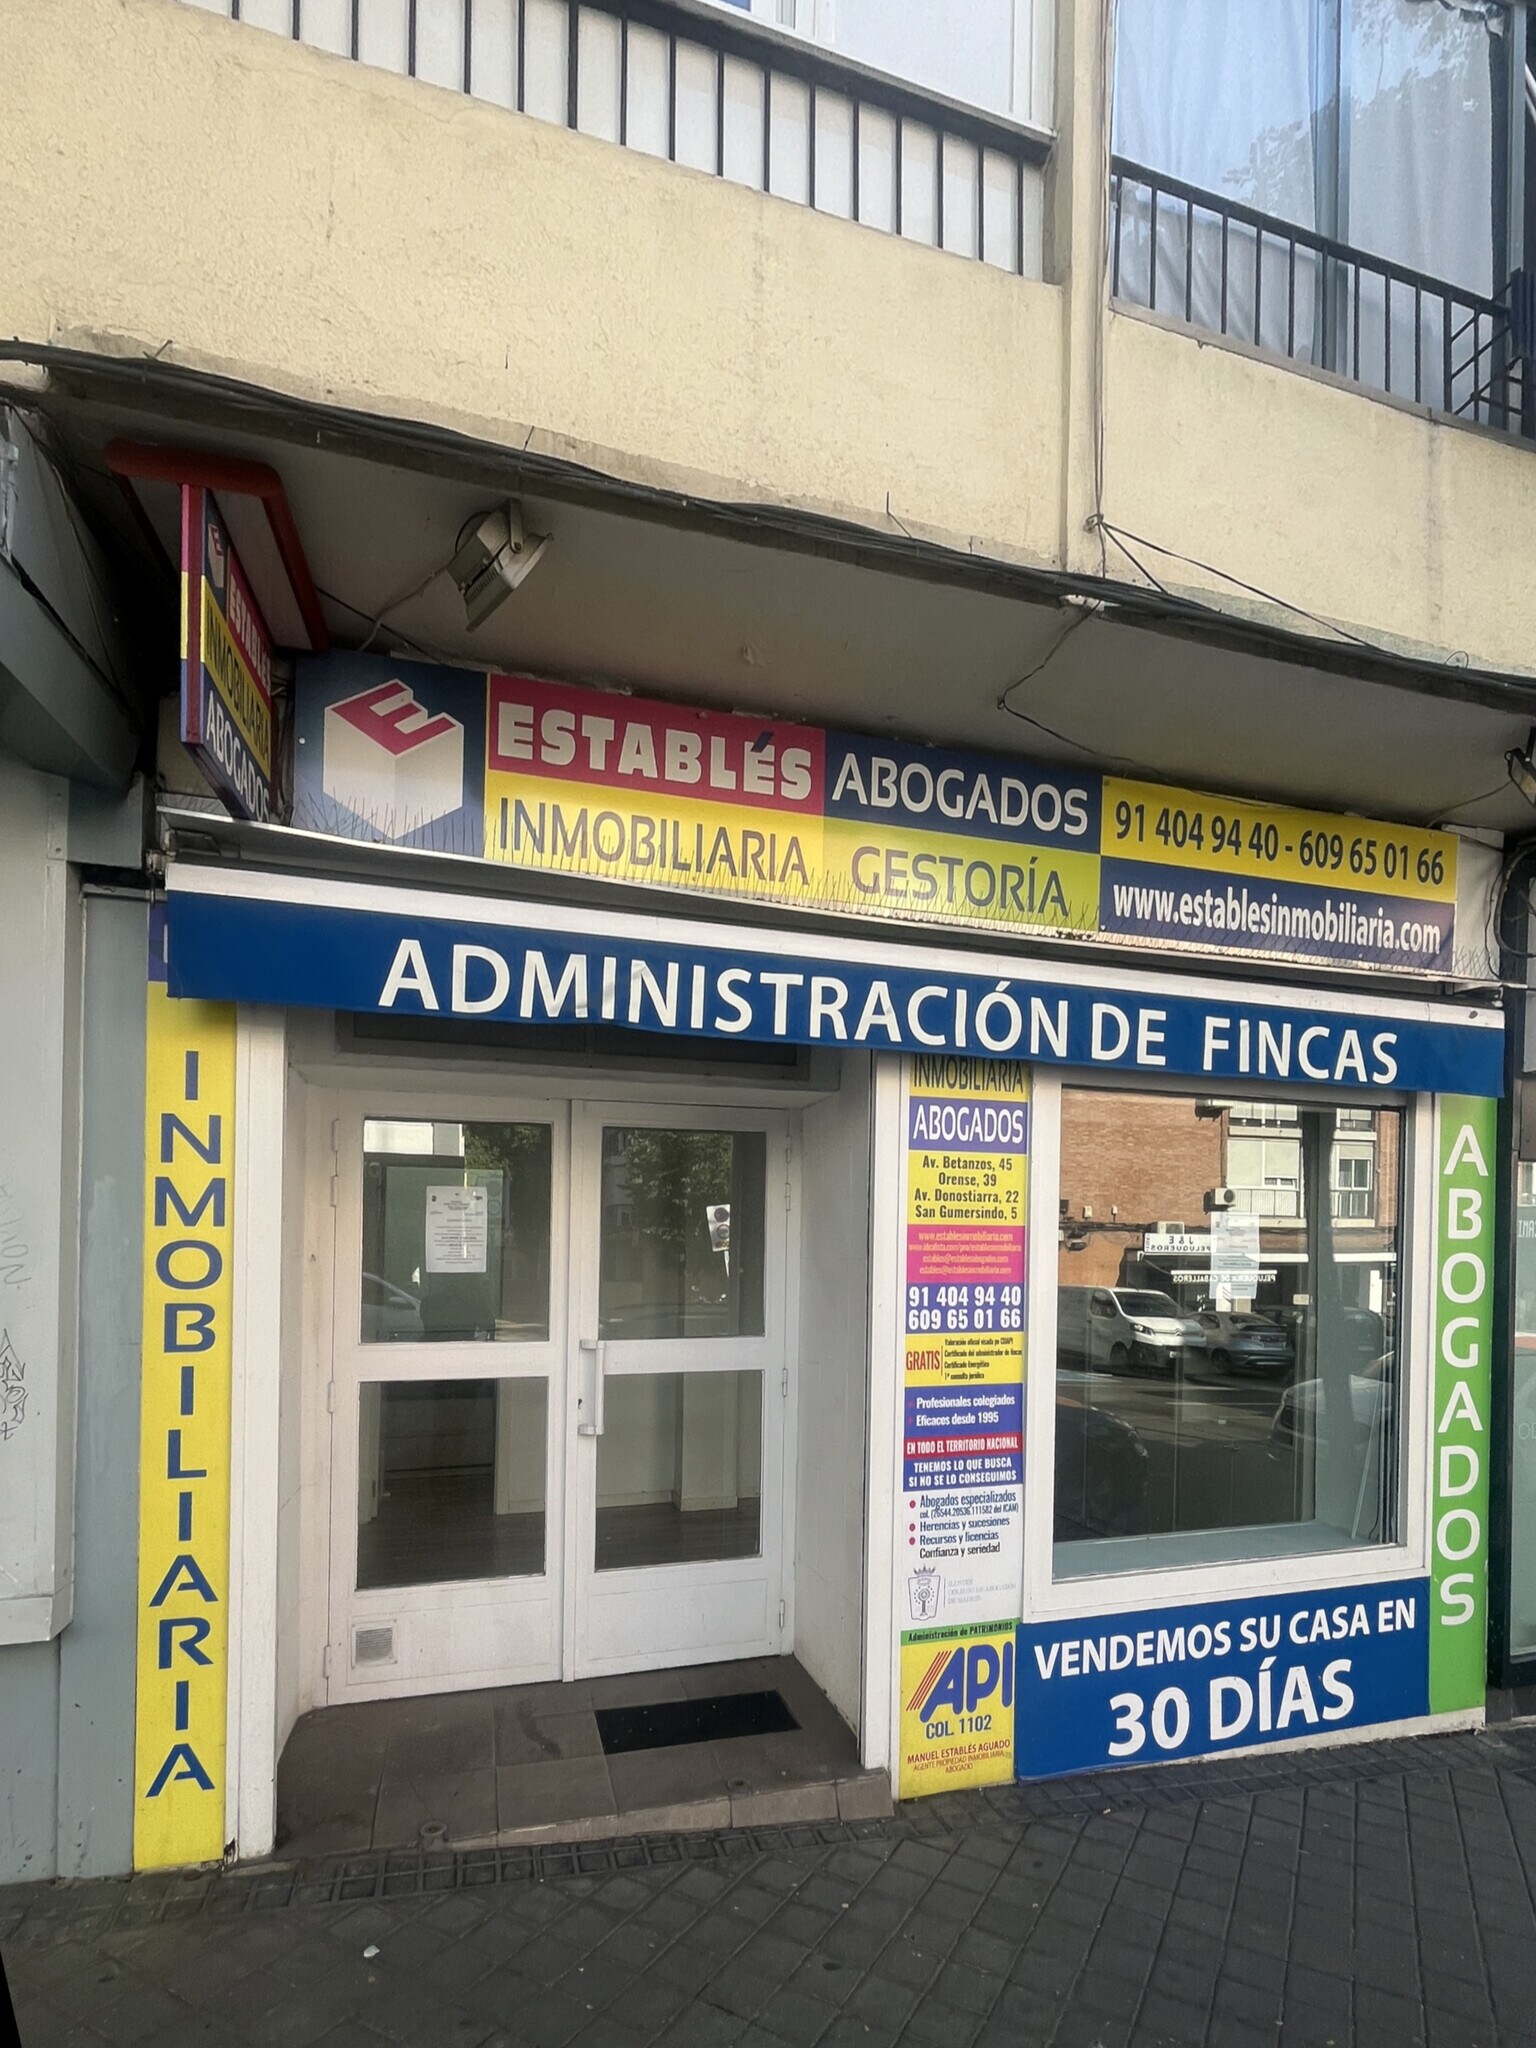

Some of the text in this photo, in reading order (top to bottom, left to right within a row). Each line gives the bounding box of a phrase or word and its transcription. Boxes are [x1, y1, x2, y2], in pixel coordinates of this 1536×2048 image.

[206, 600, 269, 758] INMOBILIARIA
[205, 690, 269, 822] ABOGADOS
[497, 701, 812, 799] ESTABLÉS
[831, 752, 1087, 836] ABOGADOS
[499, 797, 810, 885] INMOBILIARIA
[1115, 800, 1143, 840] 91
[1155, 806, 1203, 847] 404
[1211, 815, 1242, 854] 94
[1248, 821, 1279, 861] 40
[1300, 828, 1343, 872] 609
[1349, 836, 1378, 878] 65
[1383, 844, 1410, 881] 01
[1417, 847, 1444, 885] 66
[852, 845, 1068, 915] GESTORÍA
[1112, 880, 1441, 953] www.establesinmobiliaria.com
[377, 938, 1398, 1085] ADMINISTRACIÓN DE FINCAS
[913, 1055, 1024, 1093] INMOBILIARIA
[913, 1104, 1024, 1144] ABOGADOS
[923, 1155, 1012, 1173] Av. Betanzos, 45
[938, 1172, 997, 1188] Orense, 39
[914, 1188, 1020, 1205] Av. Donostiarra, 22
[915, 1204, 1018, 1220] San Gumersindo, 5
[1518, 1220, 1536, 1238] IMA
[909, 1286, 1021, 1307] 91 404 94 40
[908, 1308, 1021, 1330] 609 65 01 66
[906, 1350, 940, 1371] GRATIS
[1436, 1123, 1489, 1626] ABOGADOS
[916, 1393, 1015, 1409] Profesionales colegiados
[145, 1049, 226, 1798] INMOBILIARIA
[916, 1411, 999, 1427] Eficaces desde 1995
[907, 1436, 1018, 1455] EN TODO EL TERRITORIO NACIONAL
[914, 1457, 1012, 1473] TENEMOS LO QUE BUSCA
[909, 1469, 1016, 1488] SI NO SE LO CONSEGUIMOS
[920, 1489, 1016, 1509] Abogados especializados
[920, 1516, 1010, 1532] Herencias y sucesiones
[920, 1530, 999, 1546] Recursos y licencias
[920, 1541, 1001, 1559] Confianza y seriedad
[908, 1621, 1013, 1642] Administración de PATRIMONIOS
[1034, 1598, 1415, 1680] VENDEMOS SU CASA EN
[920, 1641, 1013, 1723] API
[1107, 1656, 1354, 1756] 30 DÍAS
[959, 1714, 992, 1734] 1102
[907, 1739, 1011, 1764] MANUEL ESTABLÉS AGUADO
[913, 1760, 935, 1772] AGENTE
[936, 1756, 967, 1768] PROPIEDAD
[967, 1750, 1004, 1762] INMOBILIARIA
[945, 1762, 973, 1774] ABOGADO
